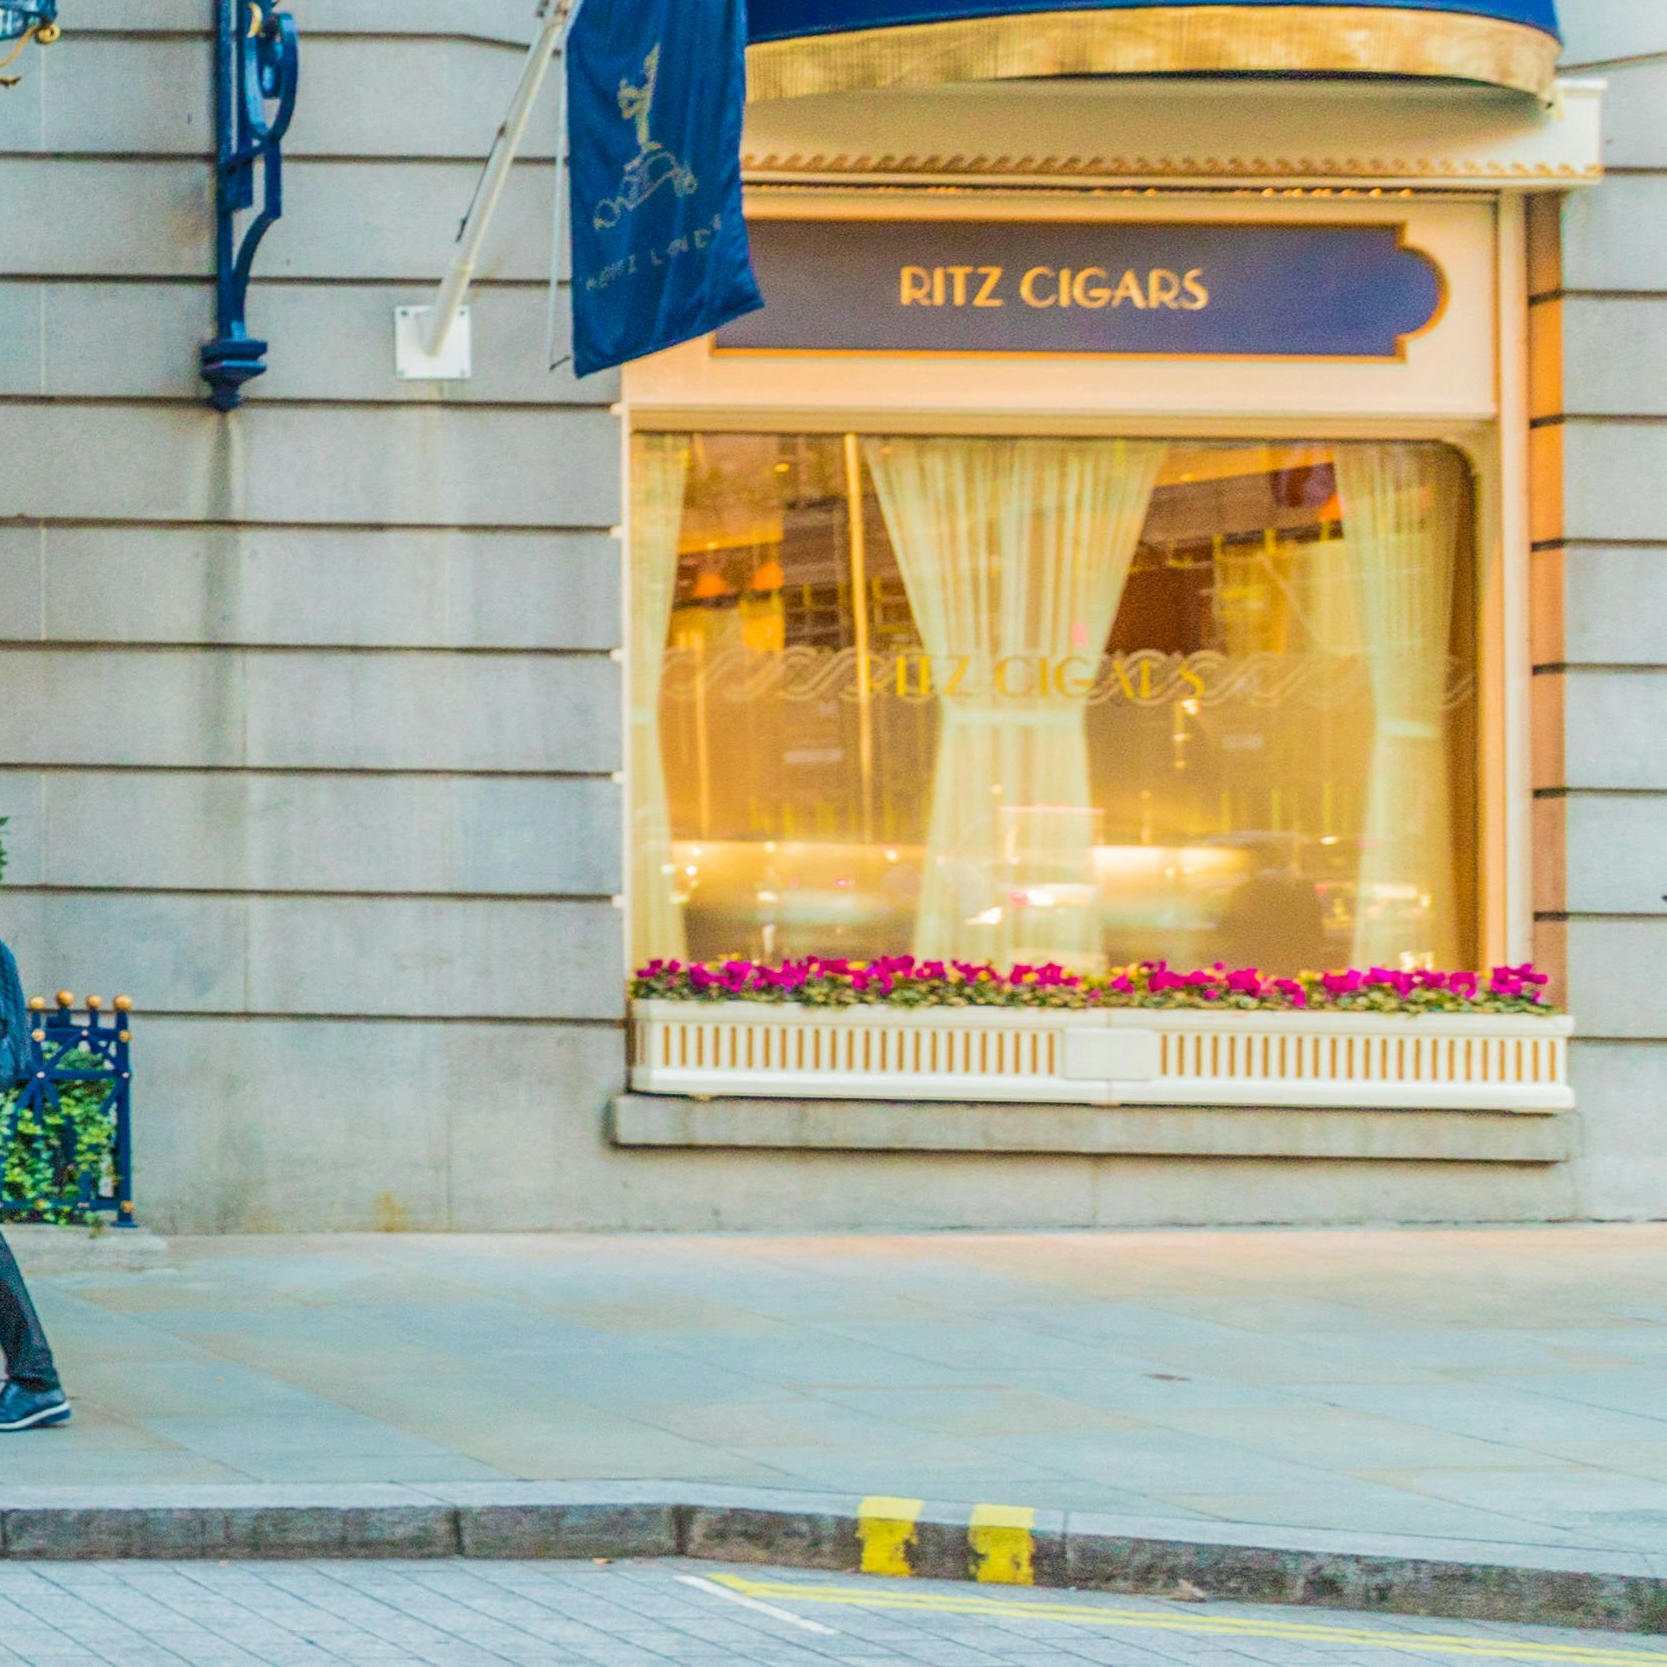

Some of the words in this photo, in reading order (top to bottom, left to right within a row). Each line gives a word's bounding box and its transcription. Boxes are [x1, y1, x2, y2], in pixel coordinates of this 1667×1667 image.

[900, 265, 1003, 307] RITZ
[1019, 265, 1210, 310] CIGARS
[866, 654, 972, 698] RITZ
[994, 654, 1205, 701] CIGARS
